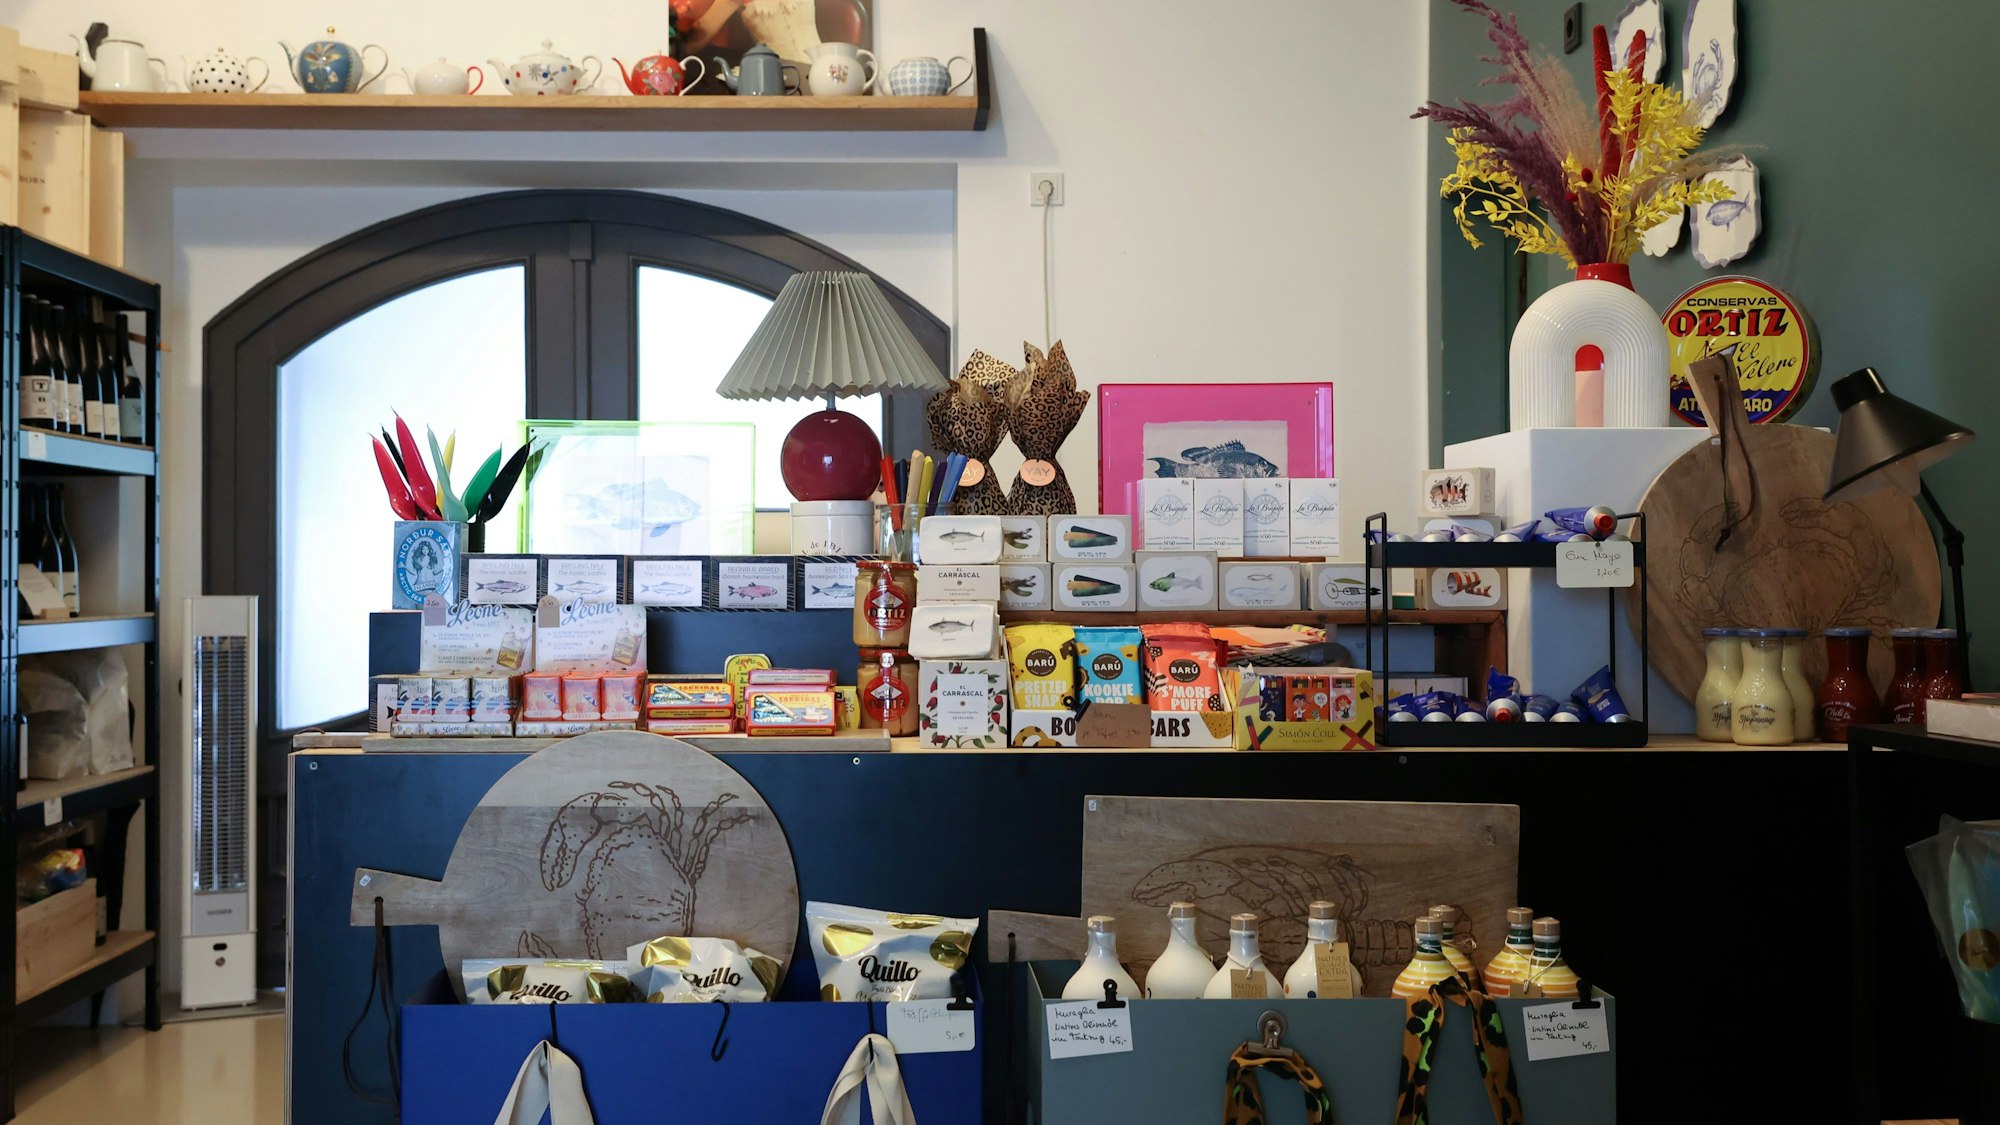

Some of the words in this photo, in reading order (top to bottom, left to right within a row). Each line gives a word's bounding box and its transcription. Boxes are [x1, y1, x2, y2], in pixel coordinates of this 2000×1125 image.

[1686, 297, 1777, 307] CONSERVAS
[1668, 308, 1789, 337] ORTIZ
[1737, 342, 1760, 362] El
[962, 467, 980, 476] AY
[1025, 467, 1051, 476] YAY
[447, 598, 507, 628] Leone
[561, 596, 620, 626] Leone
[867, 608, 906, 619] ORTIZ
[1027, 655, 1055, 667] BARÚ
[1093, 660, 1121, 671] BARÚ
[1170, 665, 1198, 674] BARÚ
[1084, 683, 1134, 697] KOOKIE
[1161, 686, 1211, 698] S'MORE
[1025, 695, 1060, 708] SNAP
[1171, 698, 1204, 711] PUFF
[1278, 728, 1311, 738] SIMÓN
[1312, 729, 1336, 738] COLL
[858, 954, 922, 983] Quillo
[1319, 967, 1348, 976] EXTRA
